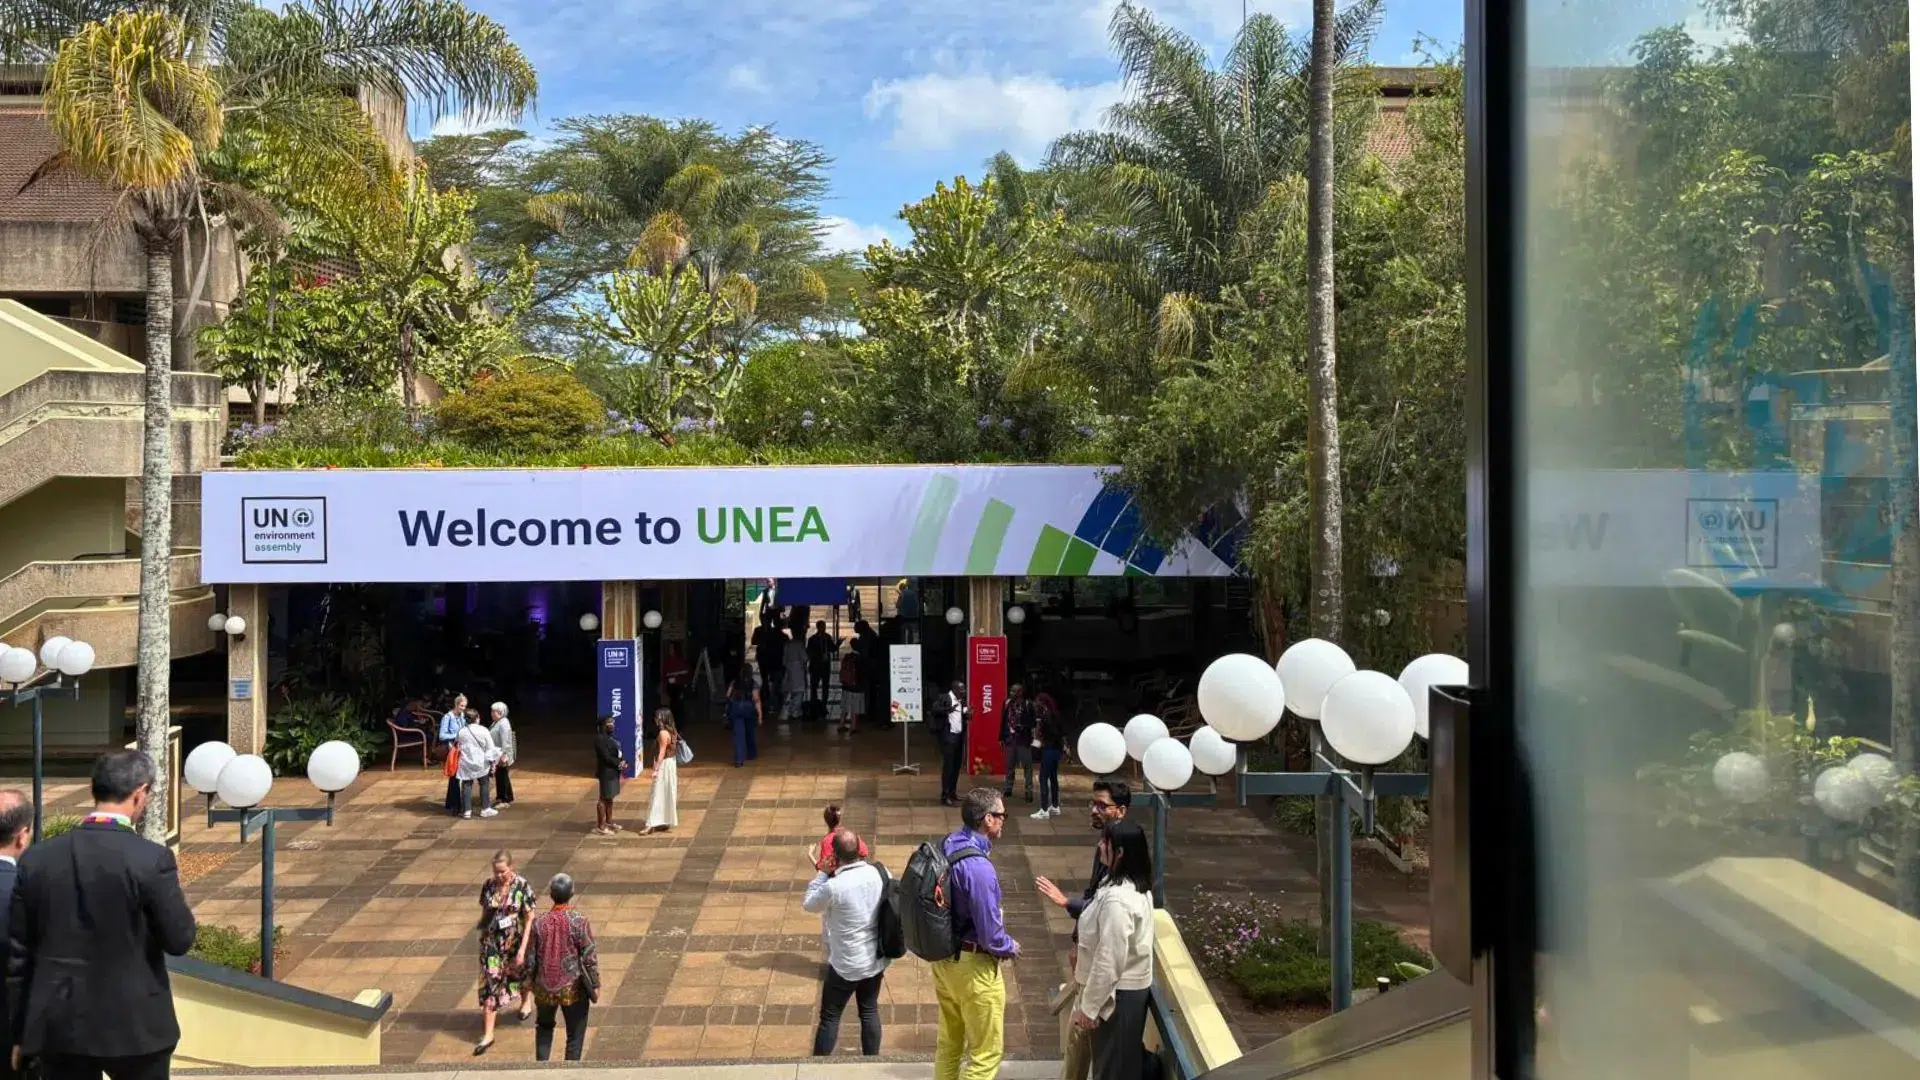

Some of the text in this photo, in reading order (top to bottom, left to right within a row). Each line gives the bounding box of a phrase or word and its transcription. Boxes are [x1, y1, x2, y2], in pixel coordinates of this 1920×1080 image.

[254, 508, 288, 528] UN
[398, 506, 830, 547] Welcome to UNEA
[254, 531, 316, 540] environment
[254, 542, 302, 554] assembly
[612, 688, 622, 718] UNEA
[983, 684, 992, 714] UNEA
